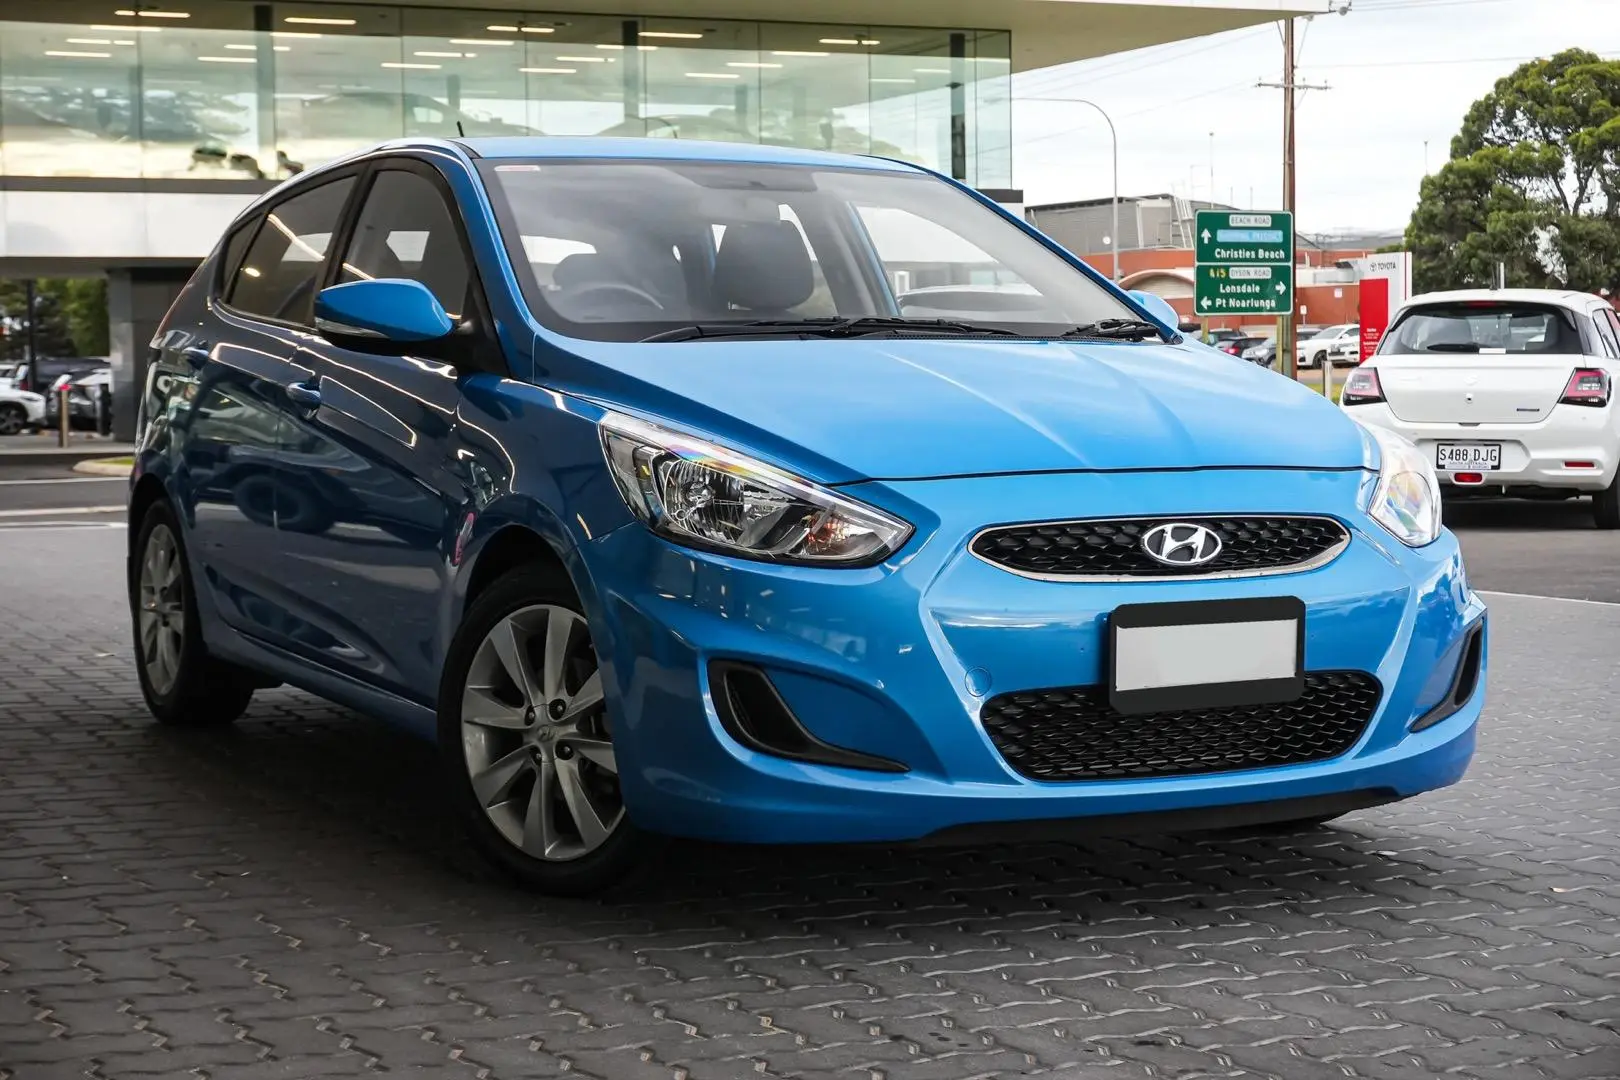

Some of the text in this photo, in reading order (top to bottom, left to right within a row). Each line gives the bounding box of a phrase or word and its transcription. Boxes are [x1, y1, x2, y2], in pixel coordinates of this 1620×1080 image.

[1215, 249, 1285, 258] Christies Beach
[1378, 262, 1396, 270] TOYOTA
[1254, 269, 1270, 277] ROAD
[1220, 284, 1260, 293] Lonsdale
[1215, 298, 1276, 309] Pt Noarlunga
[1440, 448, 1497, 461] S488 DJG
